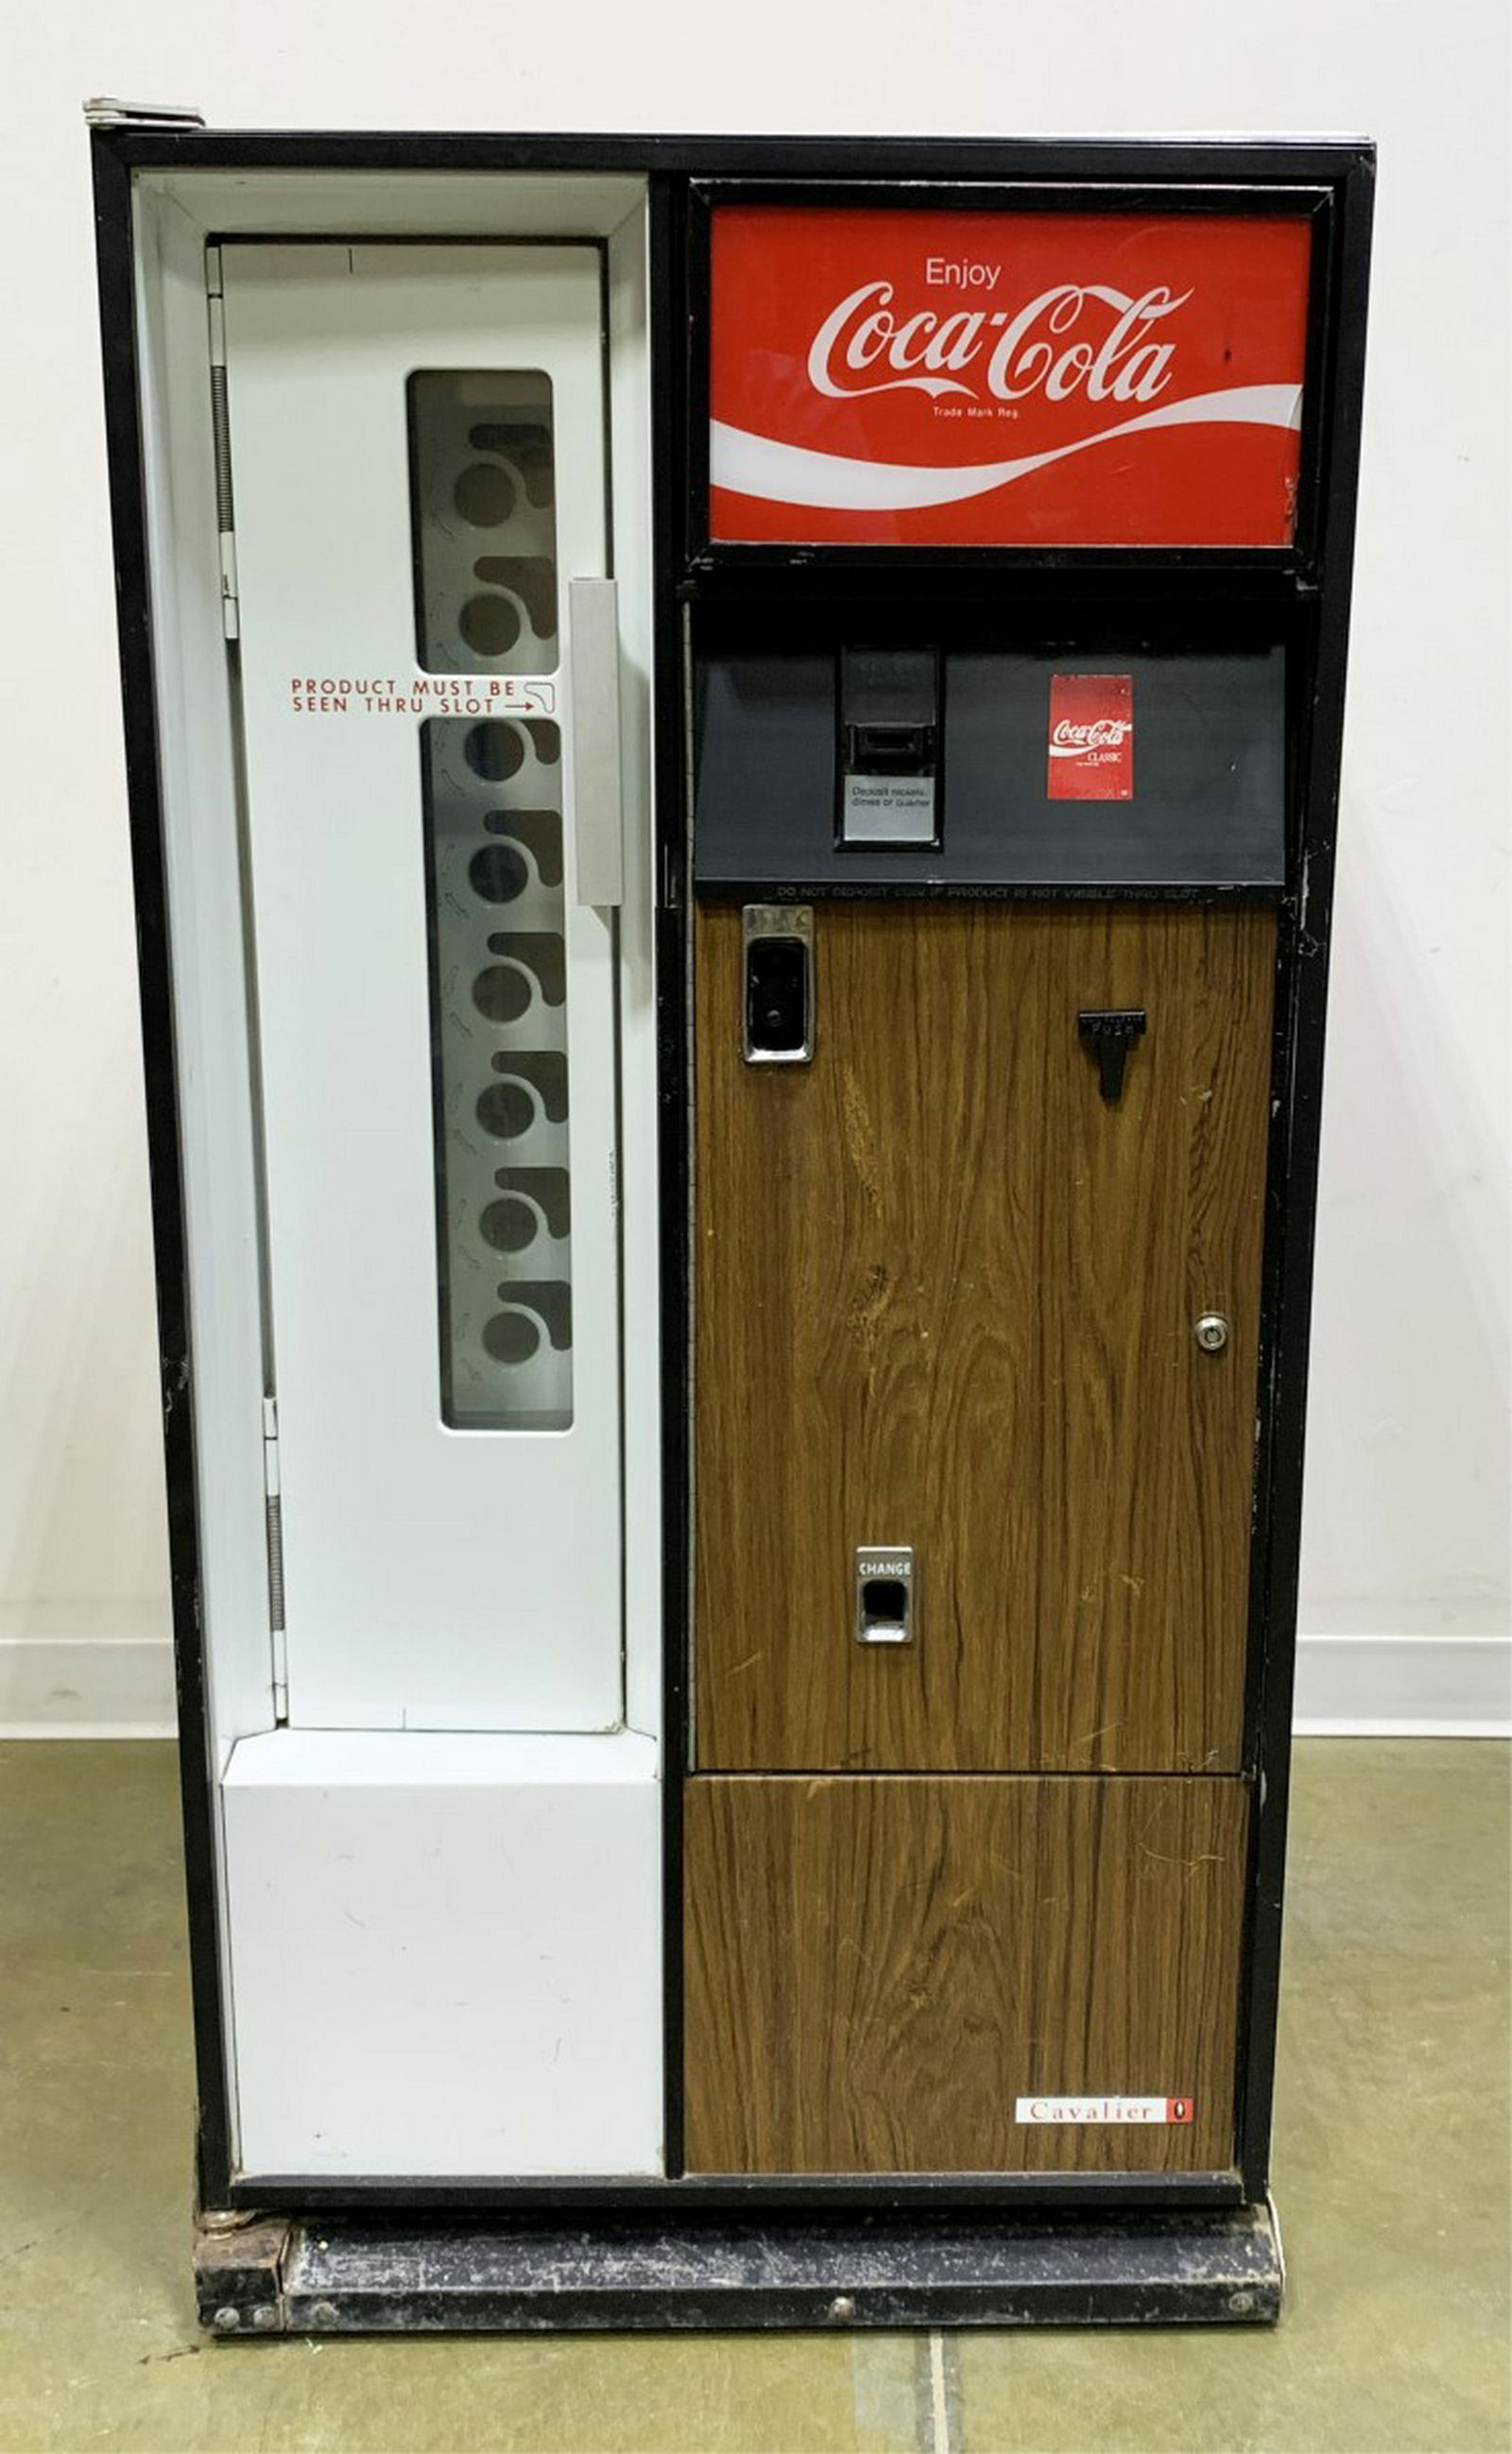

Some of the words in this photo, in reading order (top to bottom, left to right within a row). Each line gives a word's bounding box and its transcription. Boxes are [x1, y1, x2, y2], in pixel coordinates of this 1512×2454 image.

[926, 257, 1002, 291] Enjoy
[807, 280, 1196, 403] Coca-Cola
[933, 406, 962, 417] Trade
[967, 406, 993, 417] Mark
[291, 678, 397, 696] PRODUCT
[412, 680, 474, 696] MUST
[490, 680, 516, 696] BE
[292, 696, 348, 712] SEEN
[365, 697, 423, 713] THRU
[440, 698, 494, 714] SLOT
[1053, 719, 1127, 746] Coca-Cola
[1087, 751, 1123, 764] CLASSIC
[852, 786, 888, 798] Deposit
[883, 798, 893, 808] or
[777, 886, 797, 897] DO
[800, 886, 826, 897] NOT
[948, 886, 1008, 898] PRODUCT
[1031, 887, 1059, 899] NOT
[858, 1561, 912, 1576] CHANGE
[1030, 2101, 1152, 2120] Cavalier
